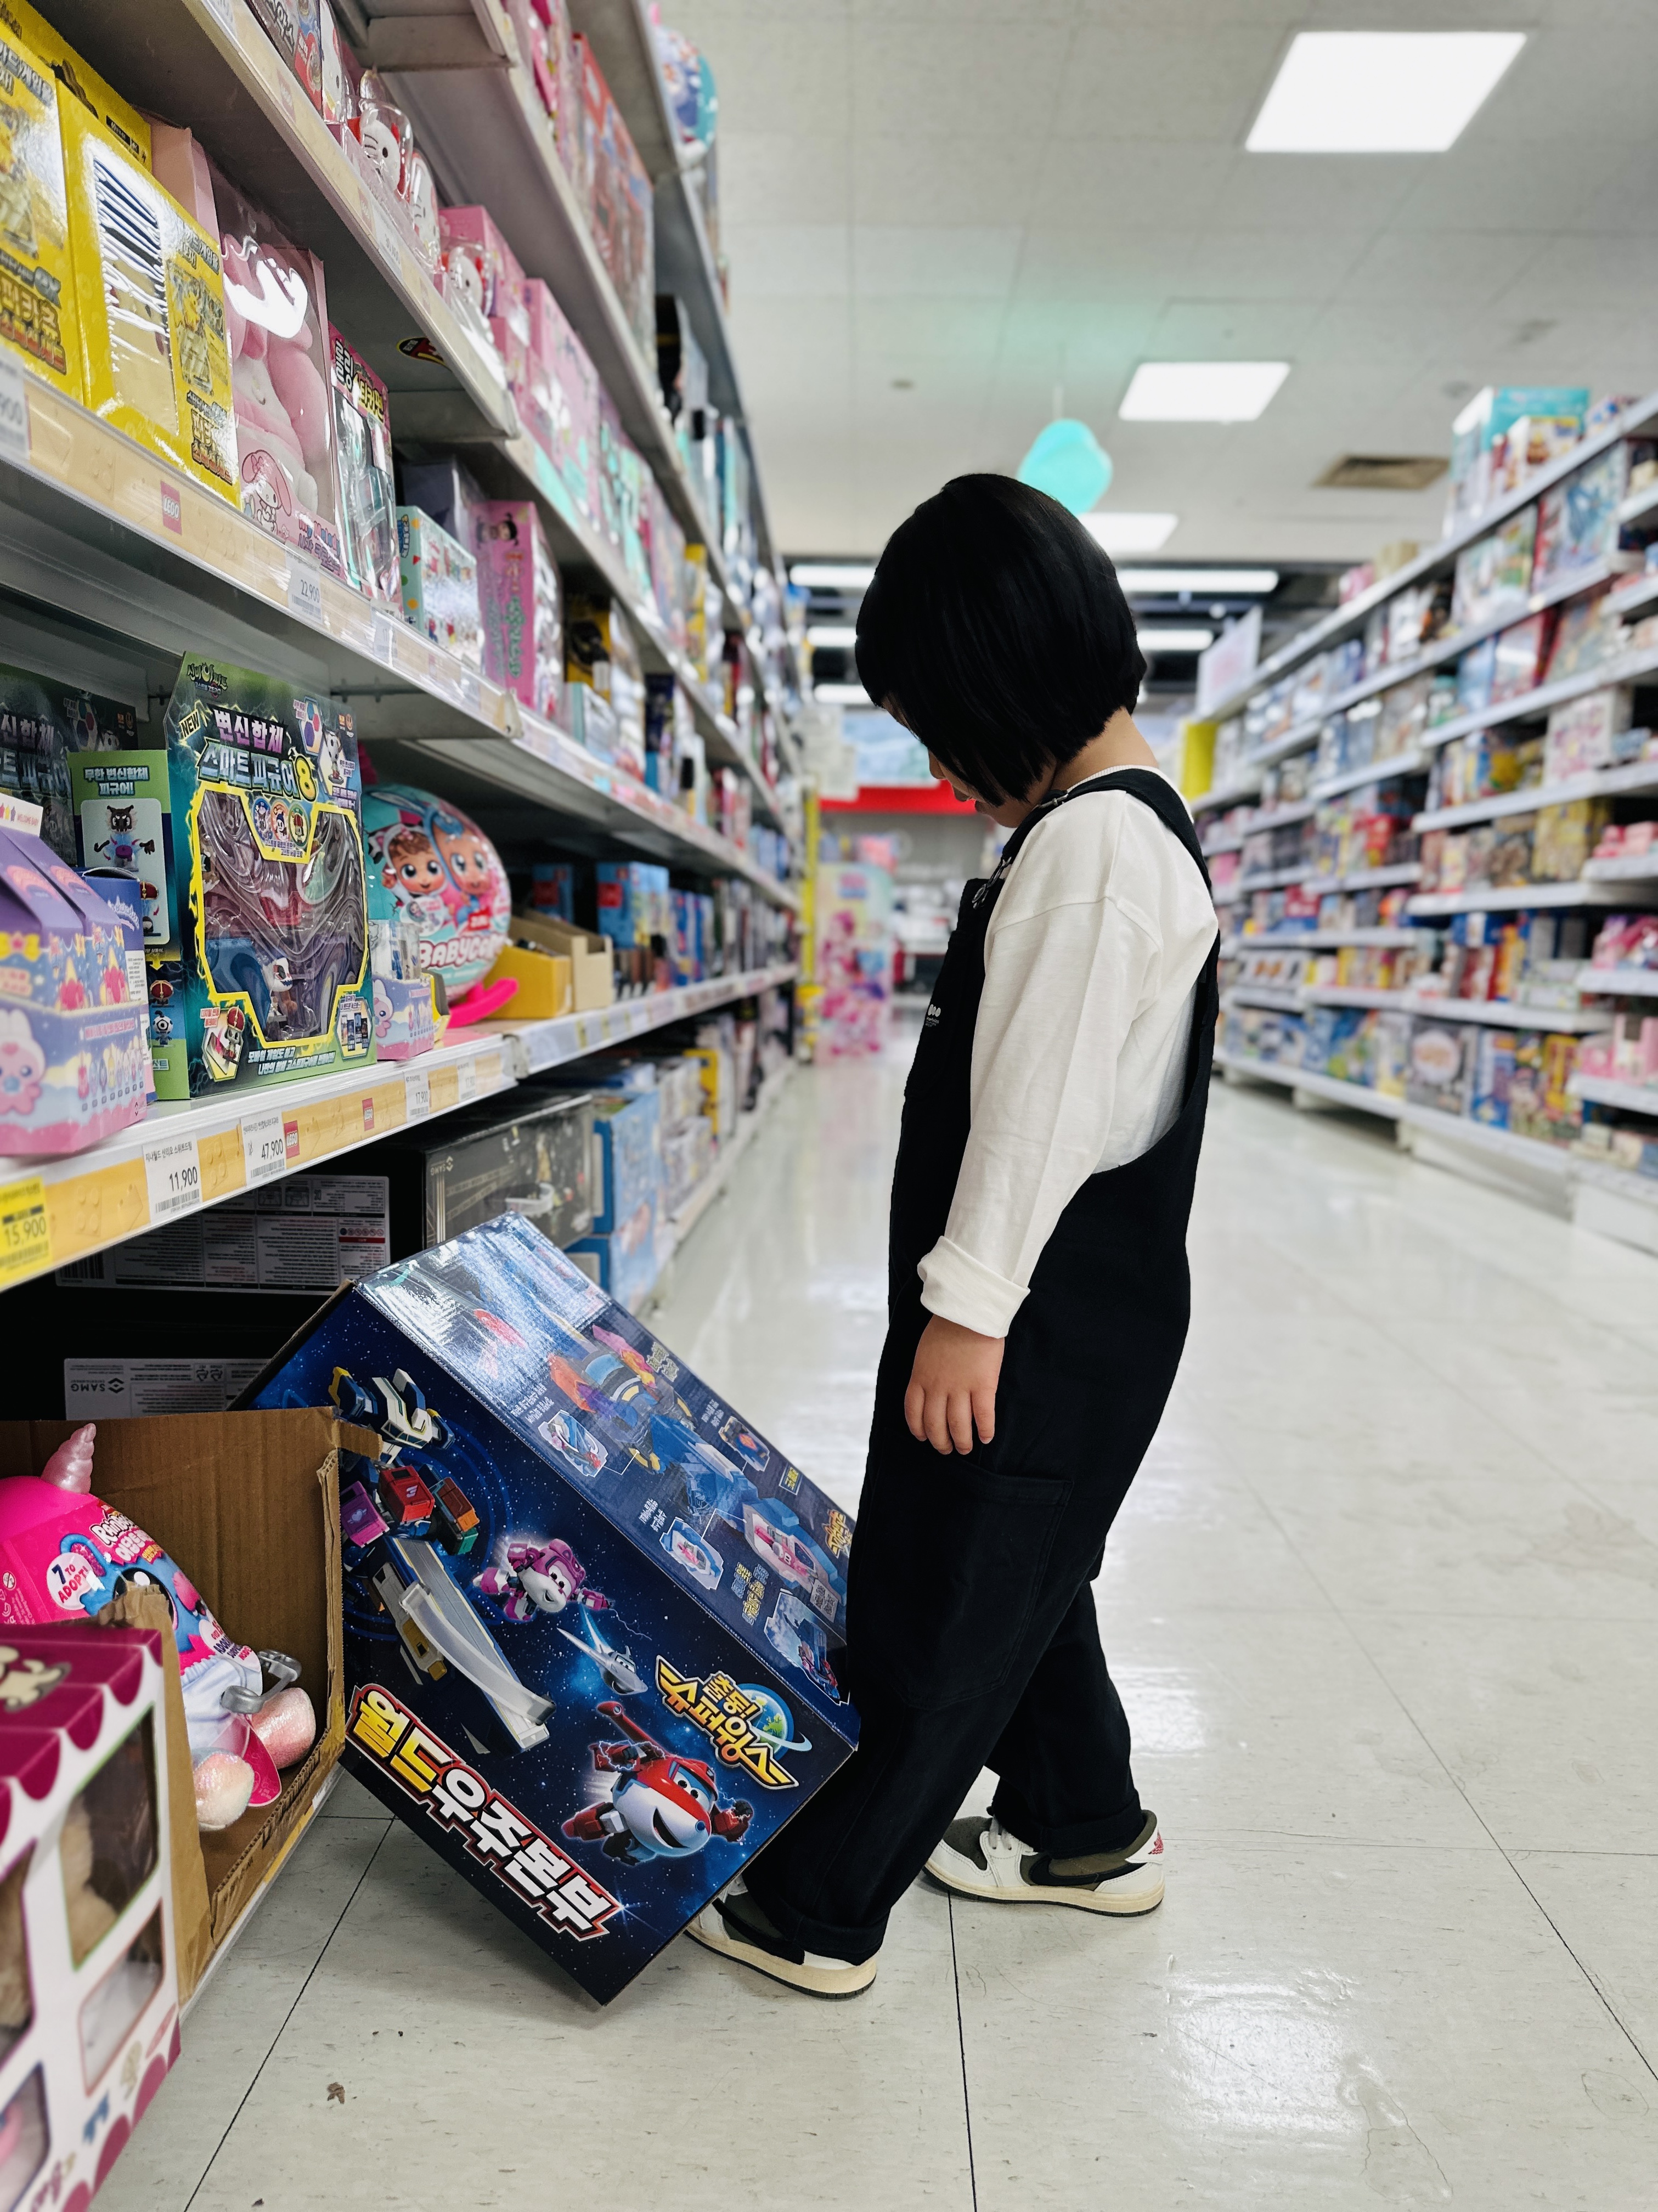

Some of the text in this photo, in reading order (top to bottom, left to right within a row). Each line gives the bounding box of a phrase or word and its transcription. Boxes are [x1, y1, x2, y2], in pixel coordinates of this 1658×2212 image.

[163, 496, 180, 520] LEGO
[301, 579, 320, 603] 22,900
[187, 662, 228, 691] 신비아파트
[181, 711, 200, 738] NEW
[213, 709, 284, 754] 변신합체
[84, 766, 149, 781] 무한 변신합체
[99, 782, 134, 795] 피규어!
[261, 1138, 284, 1160] 47,900
[286, 1131, 298, 1148] LEGO
[170, 1166, 198, 1192] 11,900
[4, 1216, 47, 1247] 15,900
[71, 1383, 105, 1392] SAMG
[52, 1564, 76, 1584] 7 TO
[58, 1565, 89, 1604] ADOPT!
[702, 1675, 758, 1718] 출동!
[659, 1661, 792, 1785] 슈퍼윙스
